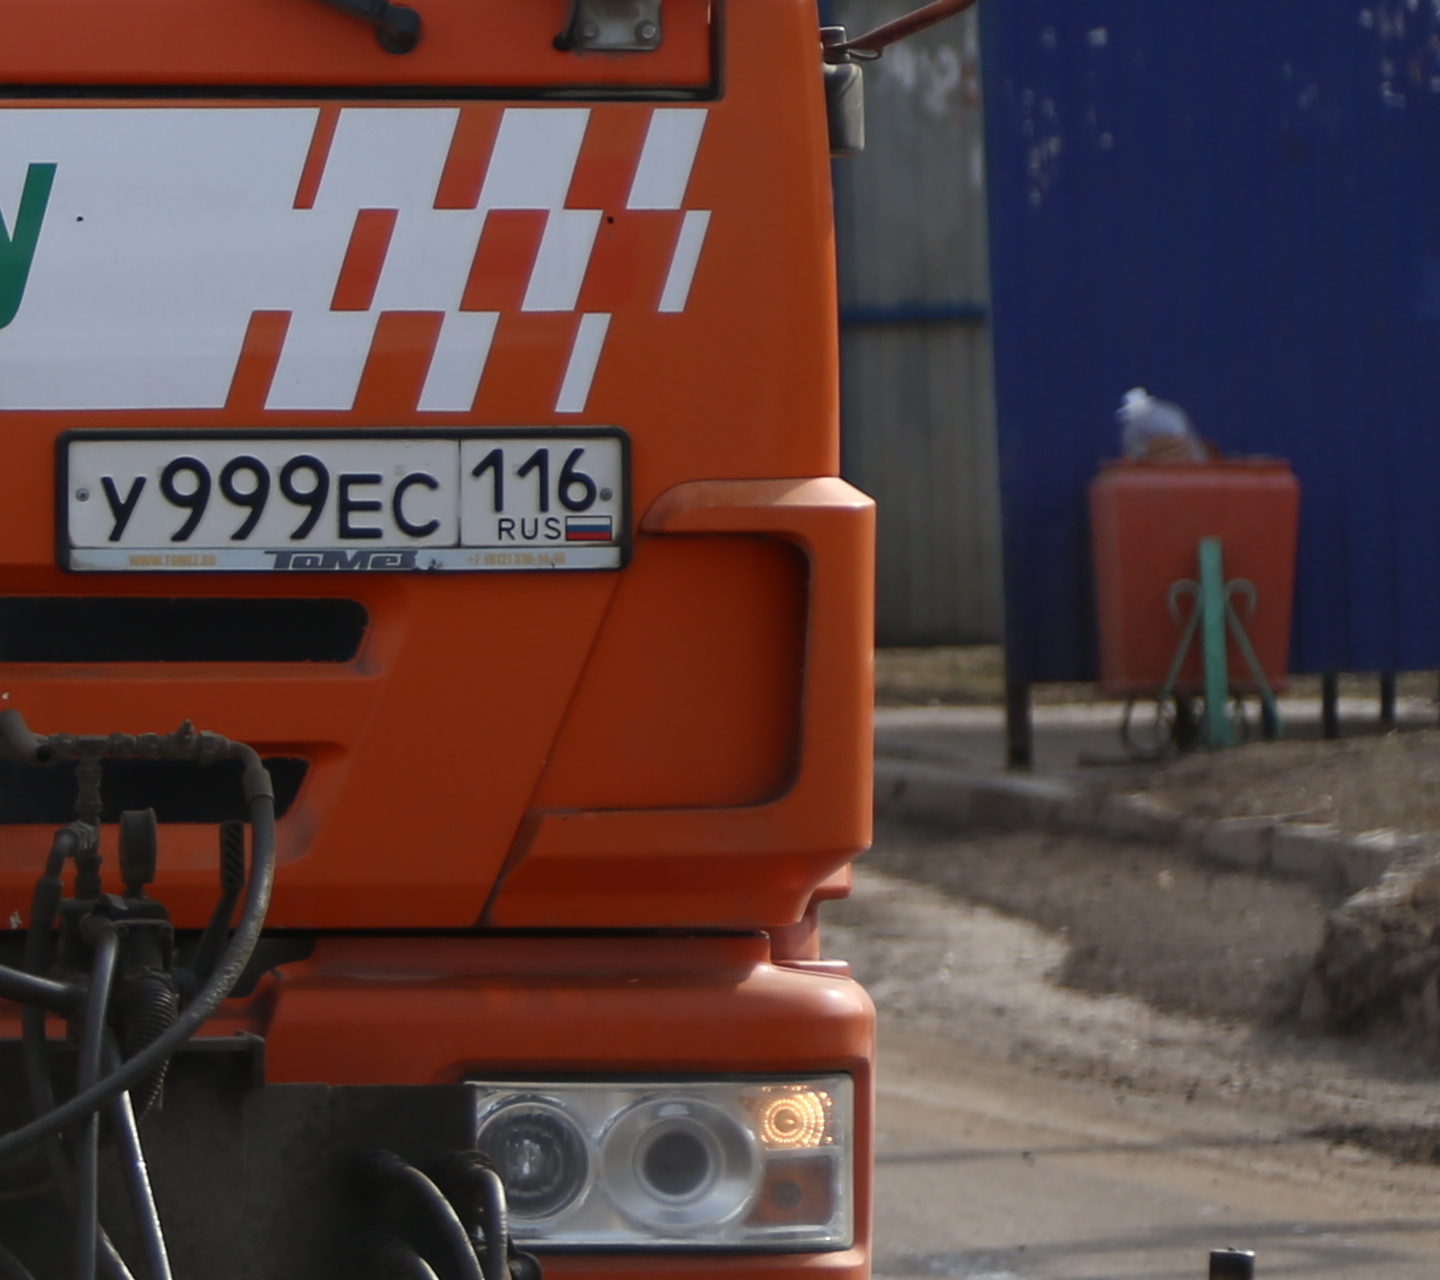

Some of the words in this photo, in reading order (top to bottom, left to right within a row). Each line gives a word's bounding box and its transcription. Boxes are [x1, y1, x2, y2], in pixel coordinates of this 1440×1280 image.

[100, 455, 440, 542] У999ЕС
[470, 447, 599, 513] 116
[497, 517, 562, 541] RUS
